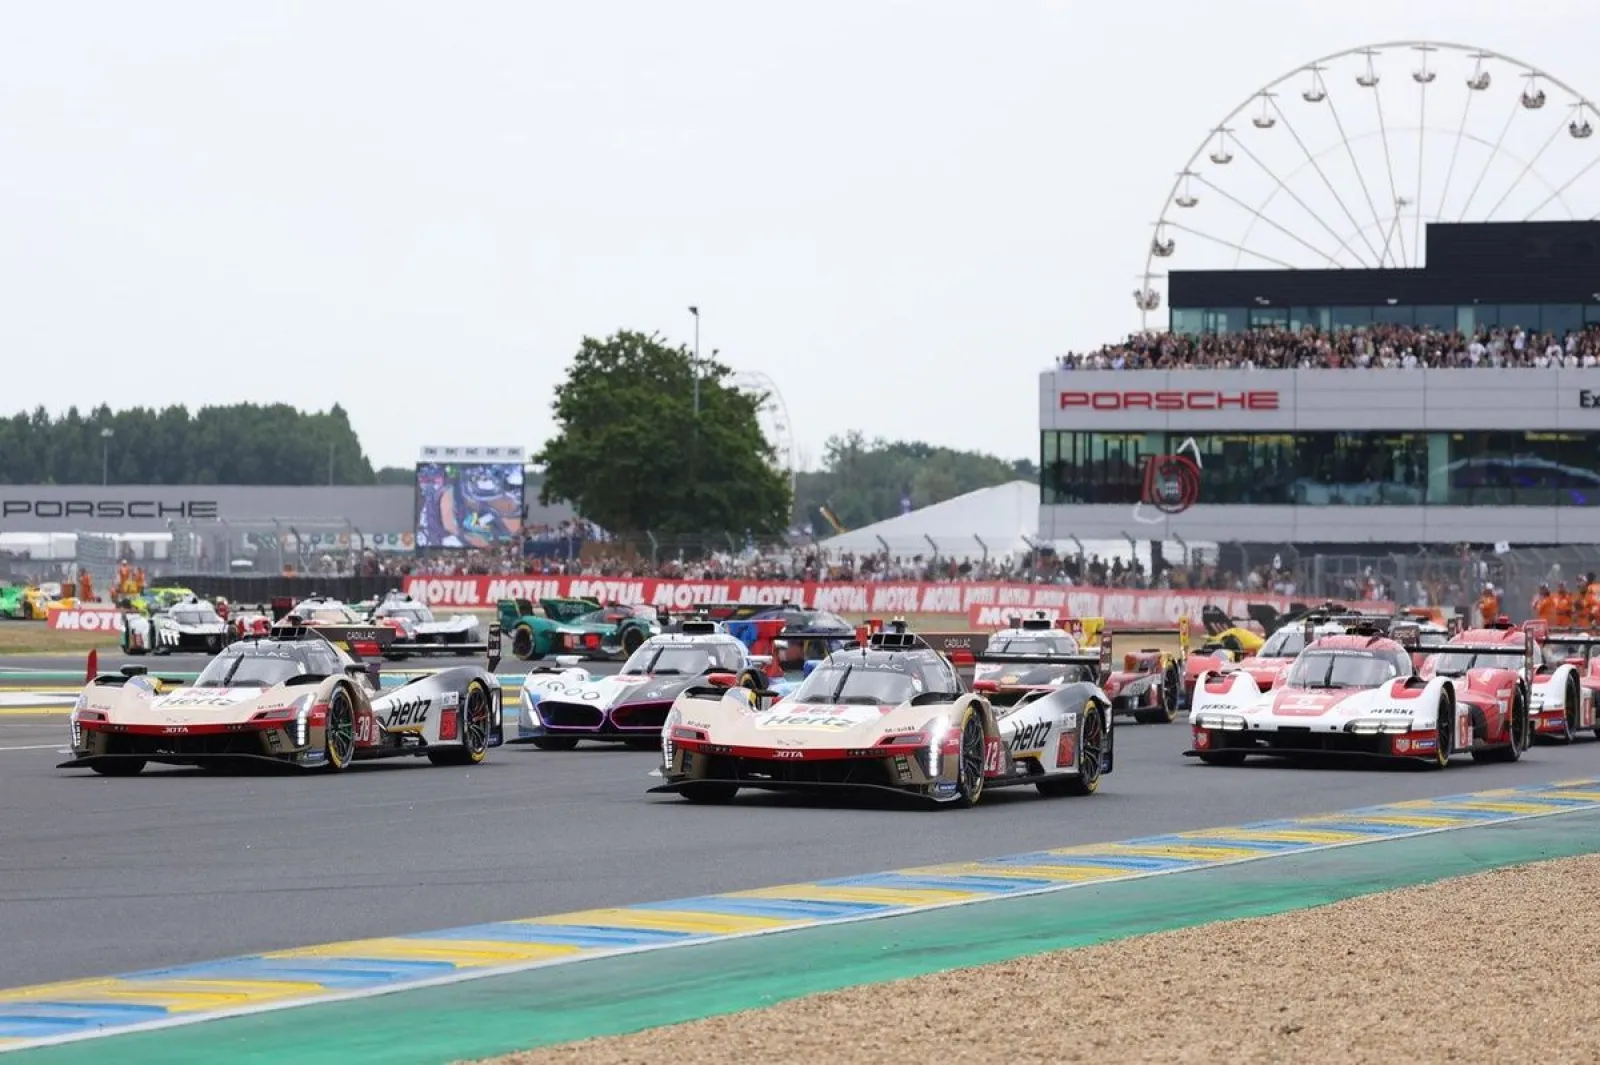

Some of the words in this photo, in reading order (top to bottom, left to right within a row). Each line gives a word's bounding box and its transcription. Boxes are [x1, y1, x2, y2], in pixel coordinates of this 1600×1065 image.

[1060, 391, 1279, 410] PORSCHE
[3, 500, 217, 518] PORSCHE
[408, 579, 480, 604] MOTUL
[487, 579, 560, 602] MOTUL
[568, 580, 644, 604] MOTUL
[652, 583, 730, 605] MOTUL
[739, 585, 805, 605] MOTUL
[346, 631, 376, 640] CADILLAC
[943, 638, 972, 648] CADILLAC
[387, 696, 432, 726] Hertz
[763, 716, 853, 728] Hertz
[1009, 717, 1053, 750] Hertz
[772, 750, 804, 758] JOTA
[983, 741, 998, 771] 12
